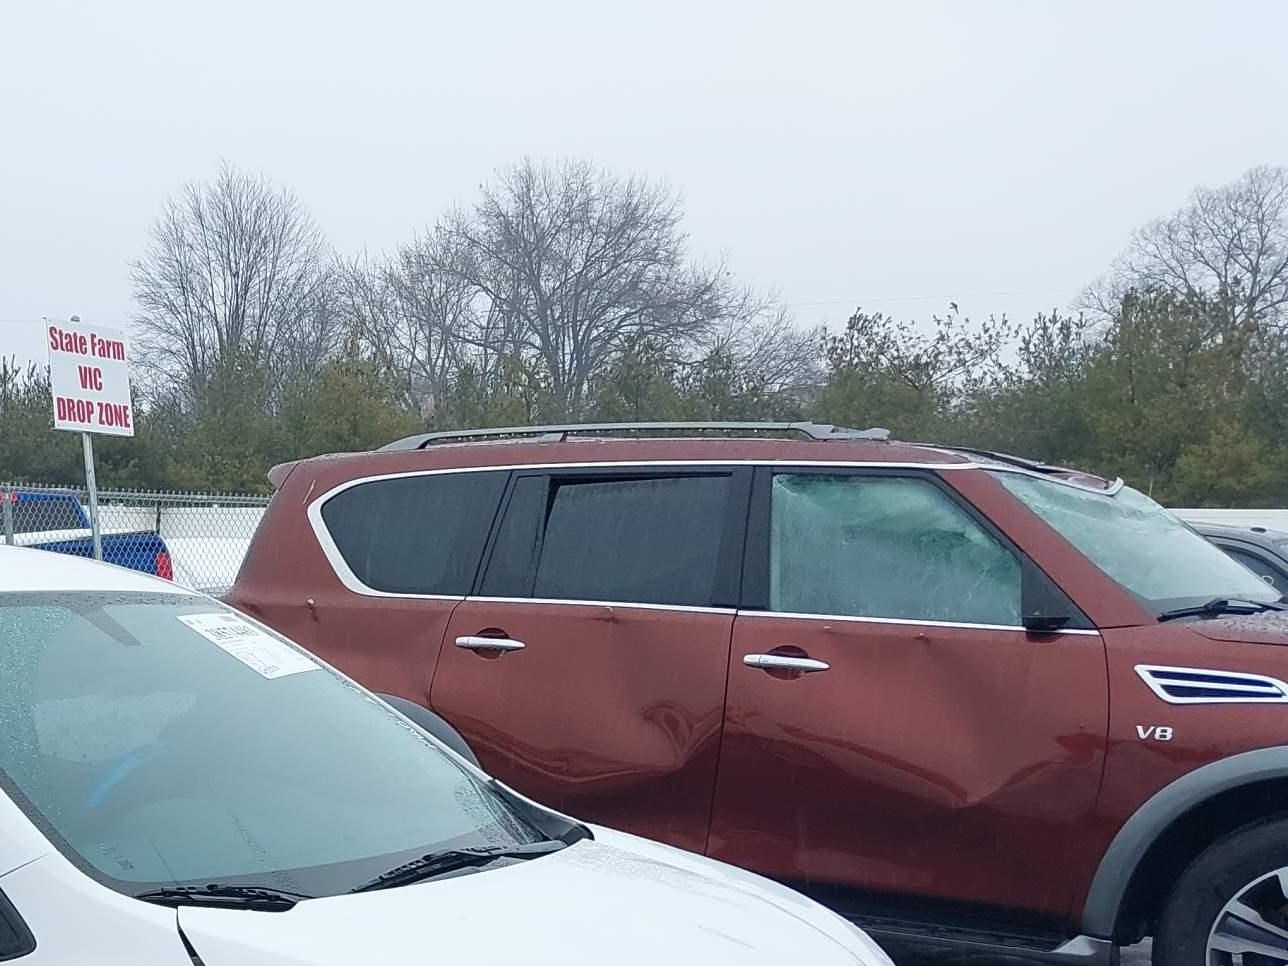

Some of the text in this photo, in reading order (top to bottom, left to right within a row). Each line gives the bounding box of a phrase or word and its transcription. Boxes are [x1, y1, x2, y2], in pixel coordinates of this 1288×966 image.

[49, 326, 125, 361] State Farm
[78, 365, 103, 391] VIC
[56, 397, 130, 428] DROP ZONE
[1136, 725, 1173, 740] V8
